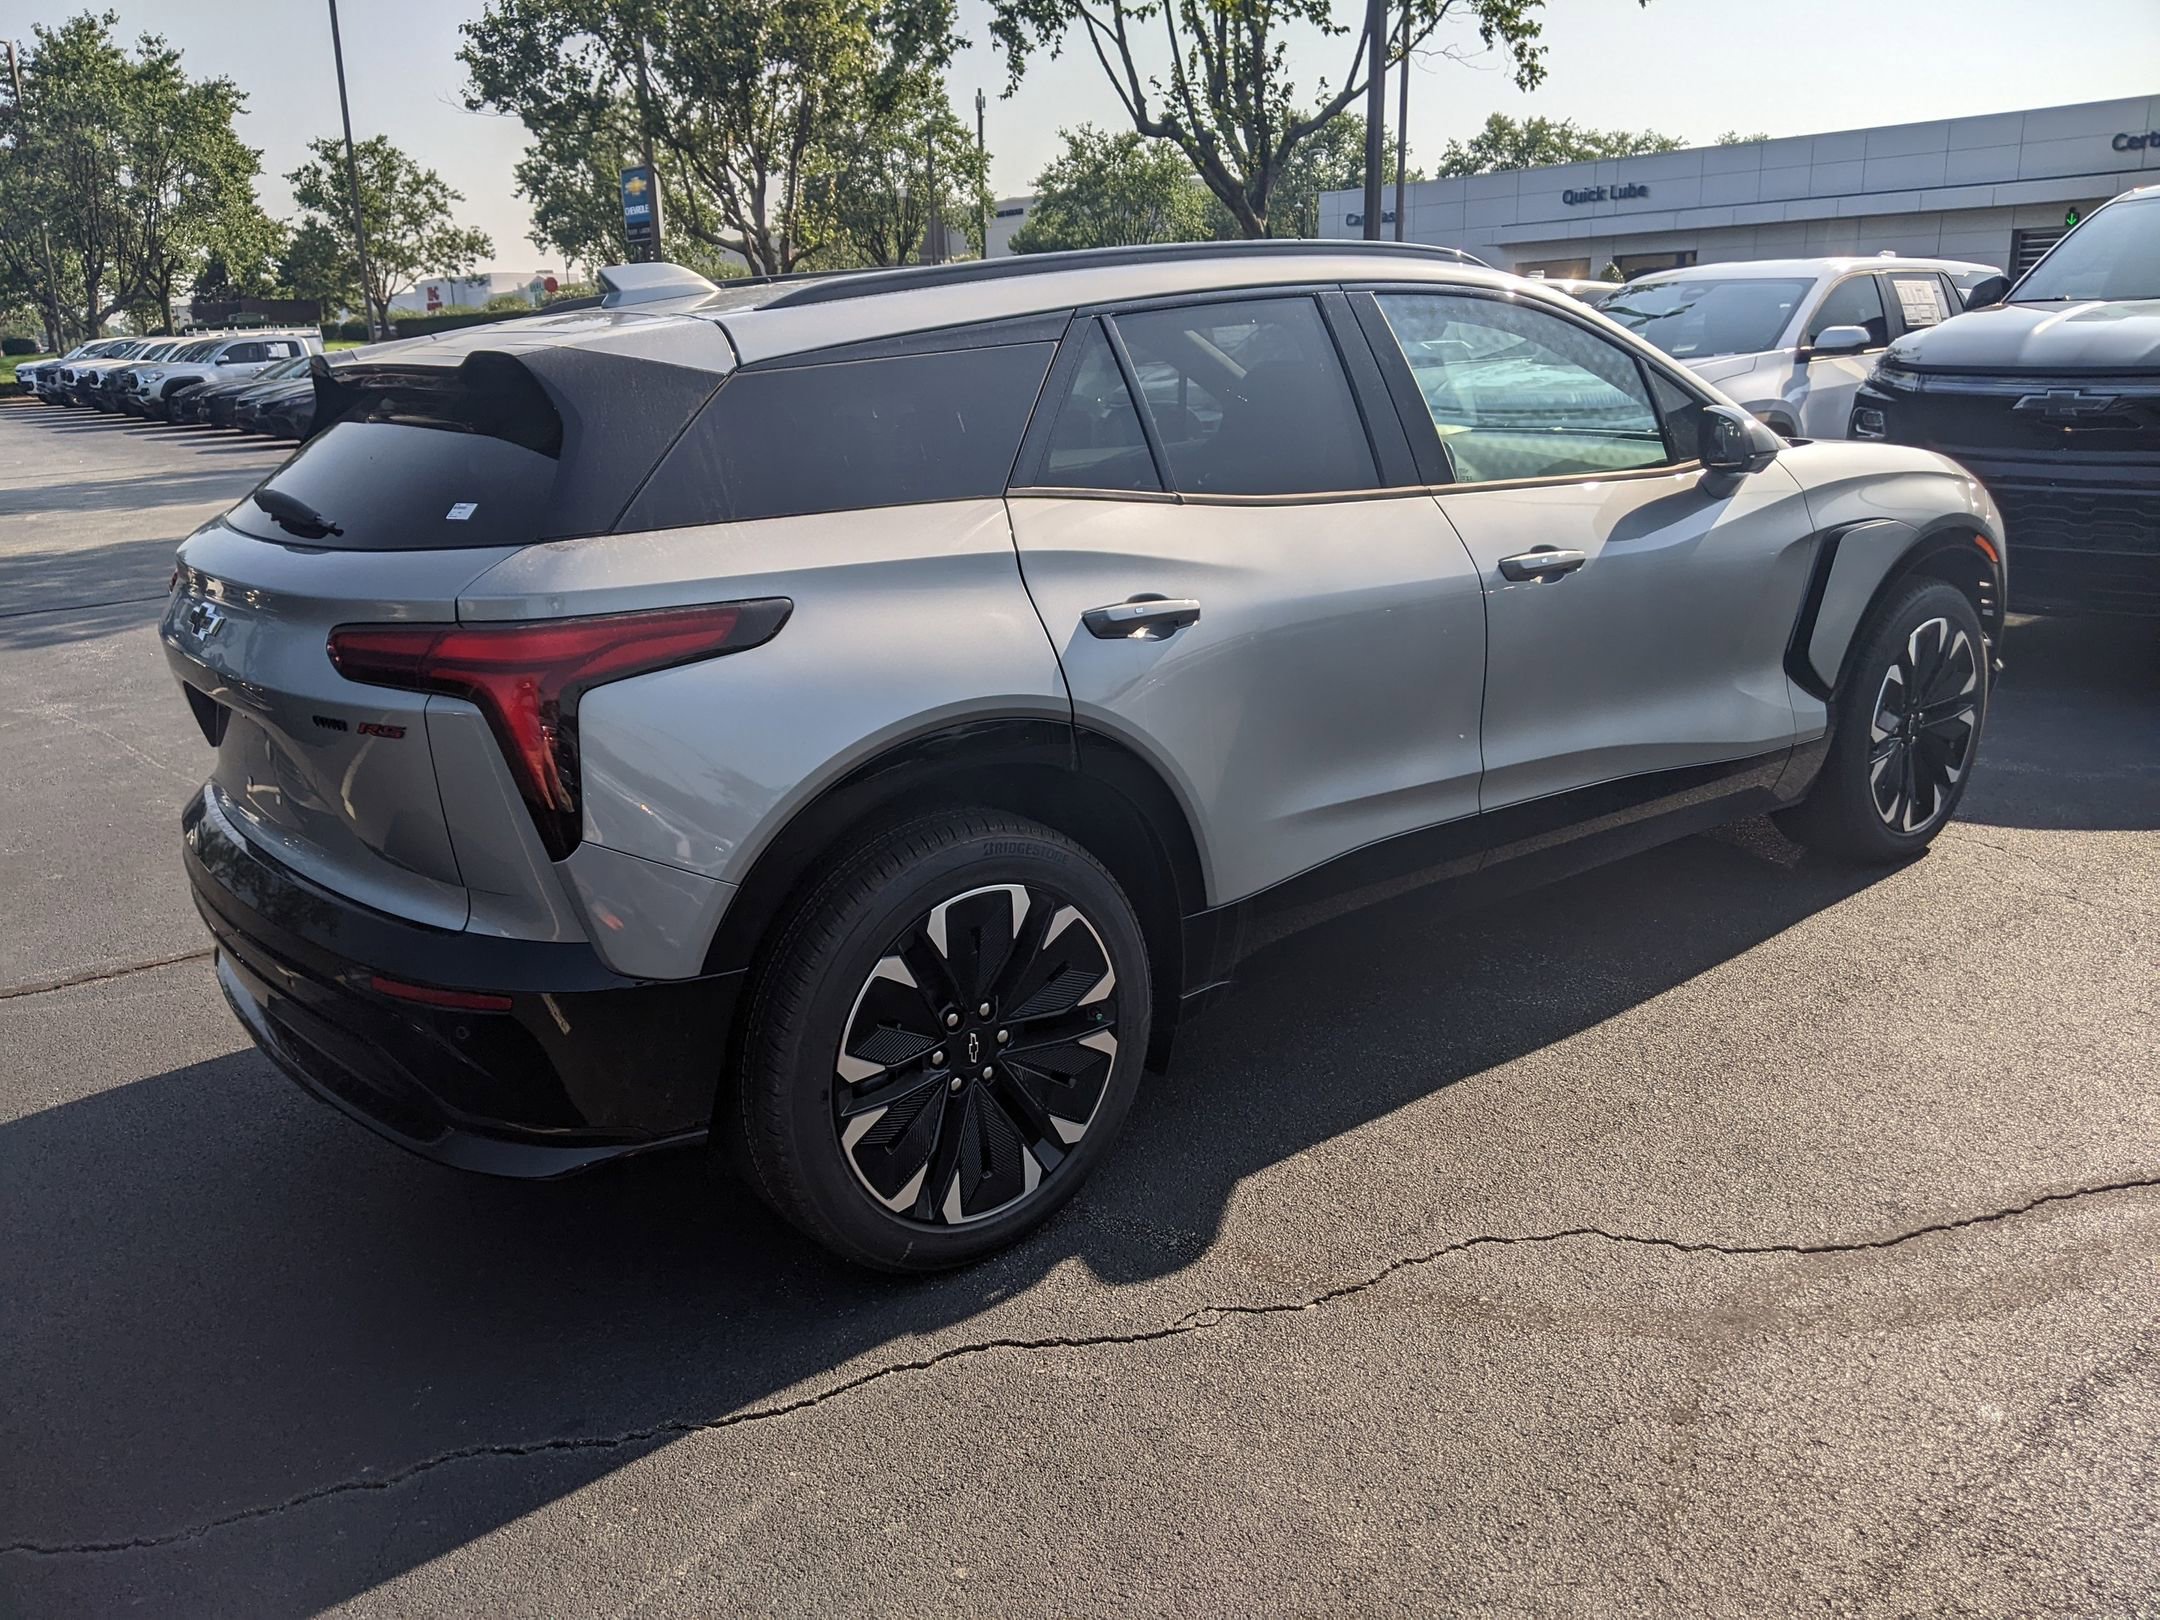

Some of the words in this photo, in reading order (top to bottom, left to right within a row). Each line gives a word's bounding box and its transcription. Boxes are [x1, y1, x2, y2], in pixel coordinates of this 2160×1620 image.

[1562, 185, 1608, 206] Quick
[1610, 182, 1649, 200] Lube
[357, 722, 407, 739] RS
[983, 841, 1069, 864] BRIDGESTONE
